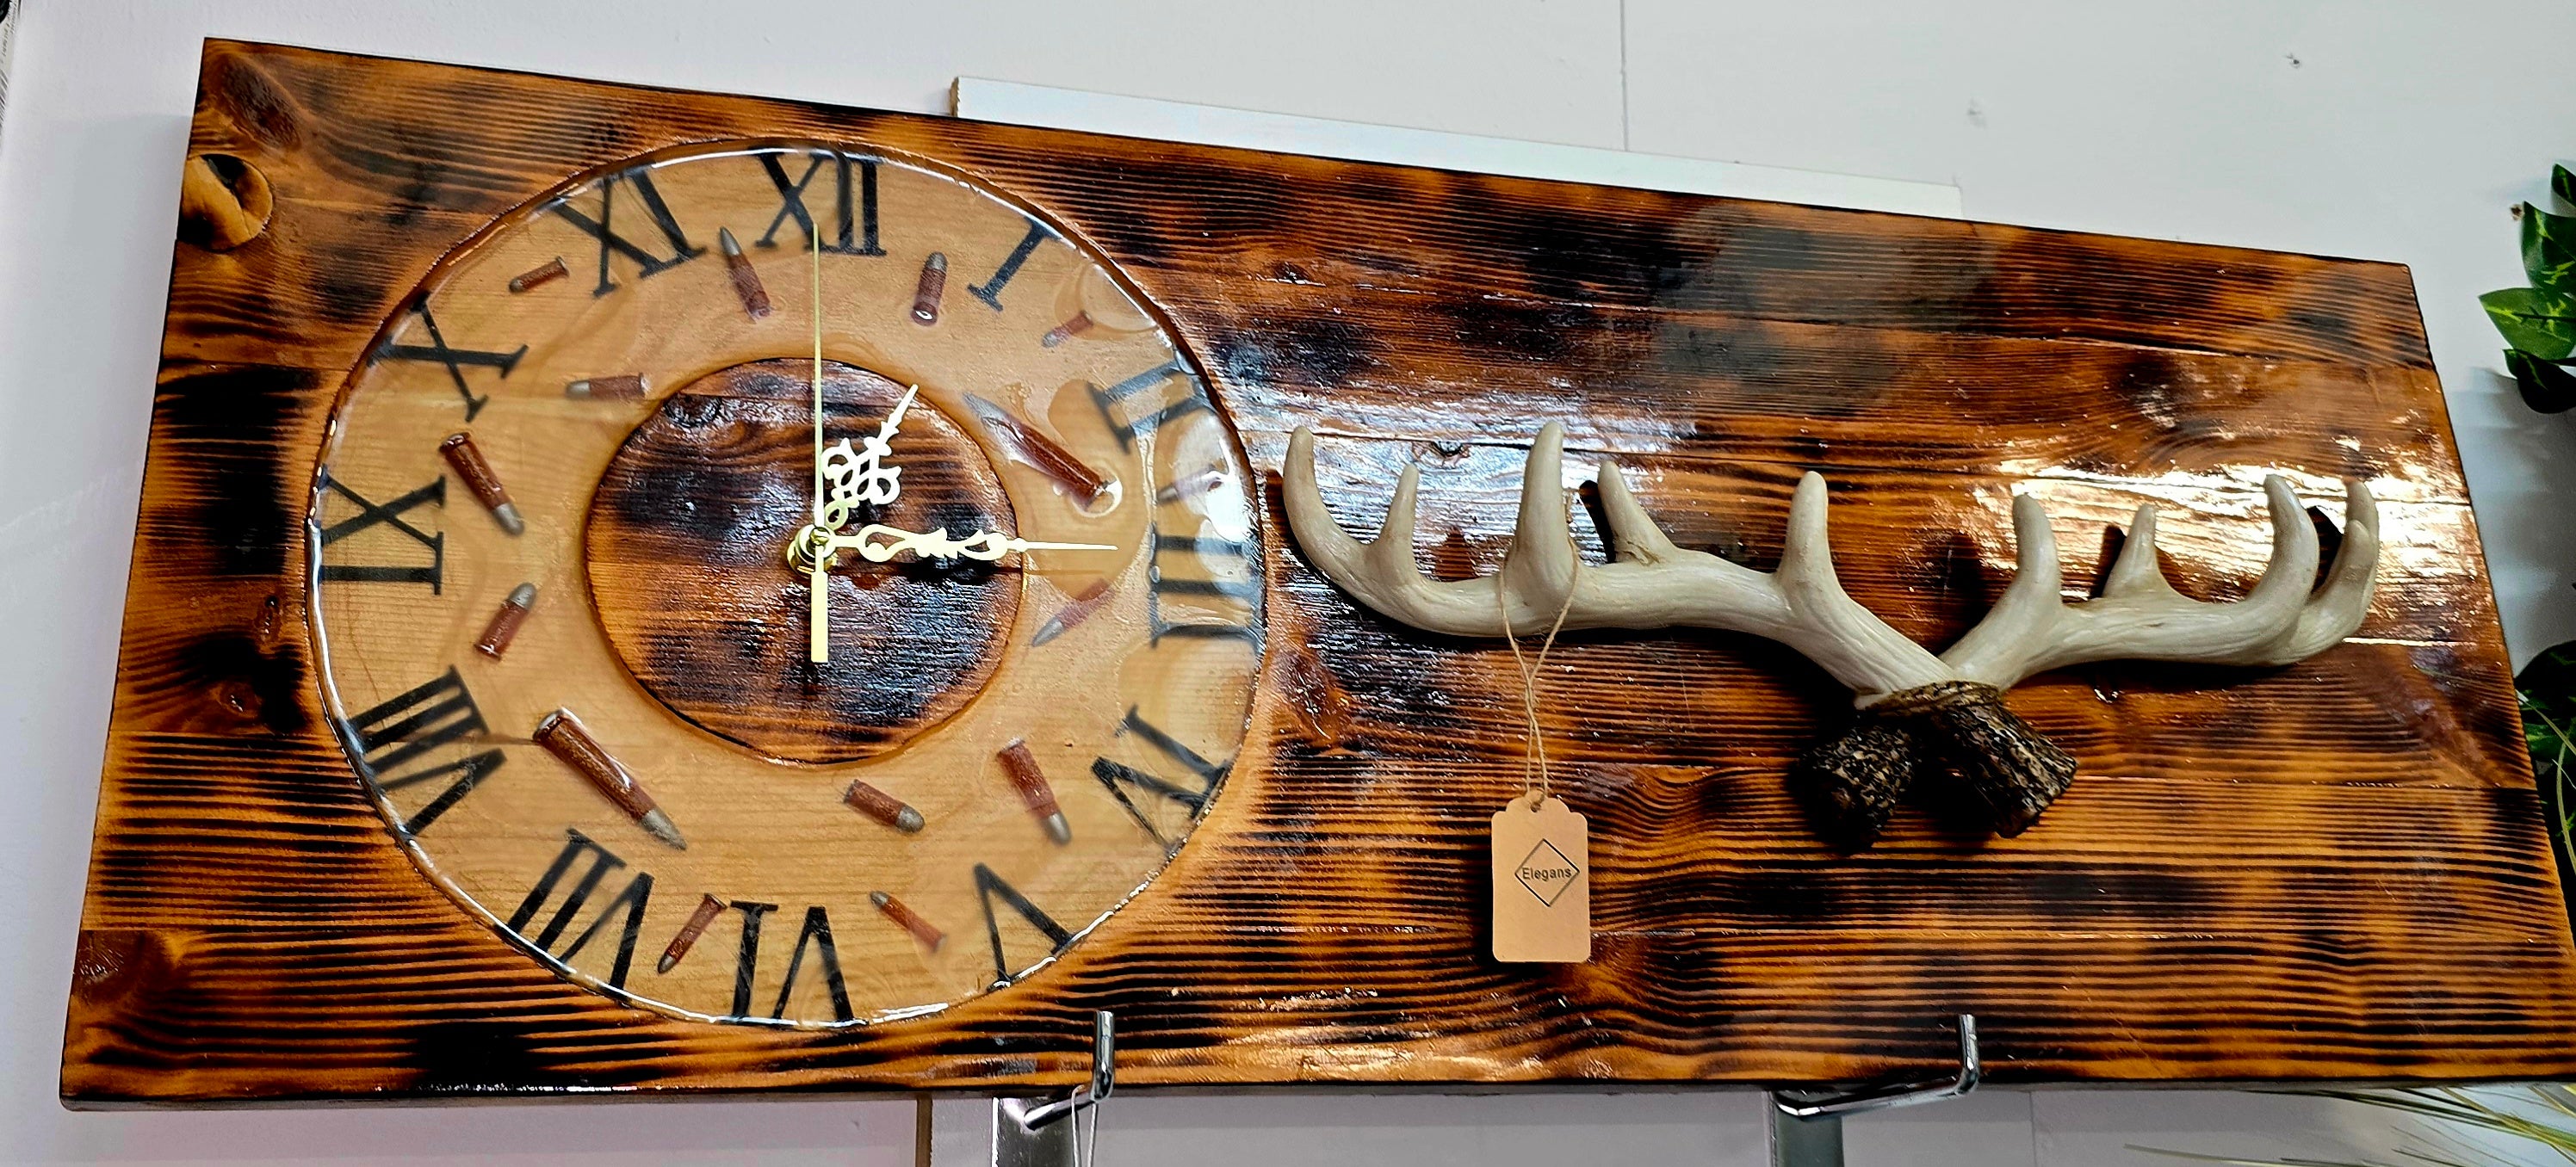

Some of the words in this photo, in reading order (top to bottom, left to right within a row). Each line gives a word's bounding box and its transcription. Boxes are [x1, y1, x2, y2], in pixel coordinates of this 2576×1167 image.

[544, 167, 708, 297] XI
[754, 151, 887, 256] XII
[967, 213, 1062, 312] I
[368, 292, 529, 423] X
[317, 463, 447, 596] IX
[338, 664, 506, 838] VIII
[1090, 704, 1235, 861] IV
[492, 826, 654, 1003] VII
[974, 861, 1081, 990] V
[1522, 867, 1571, 881] Elegans
[730, 899, 866, 1026] VI
